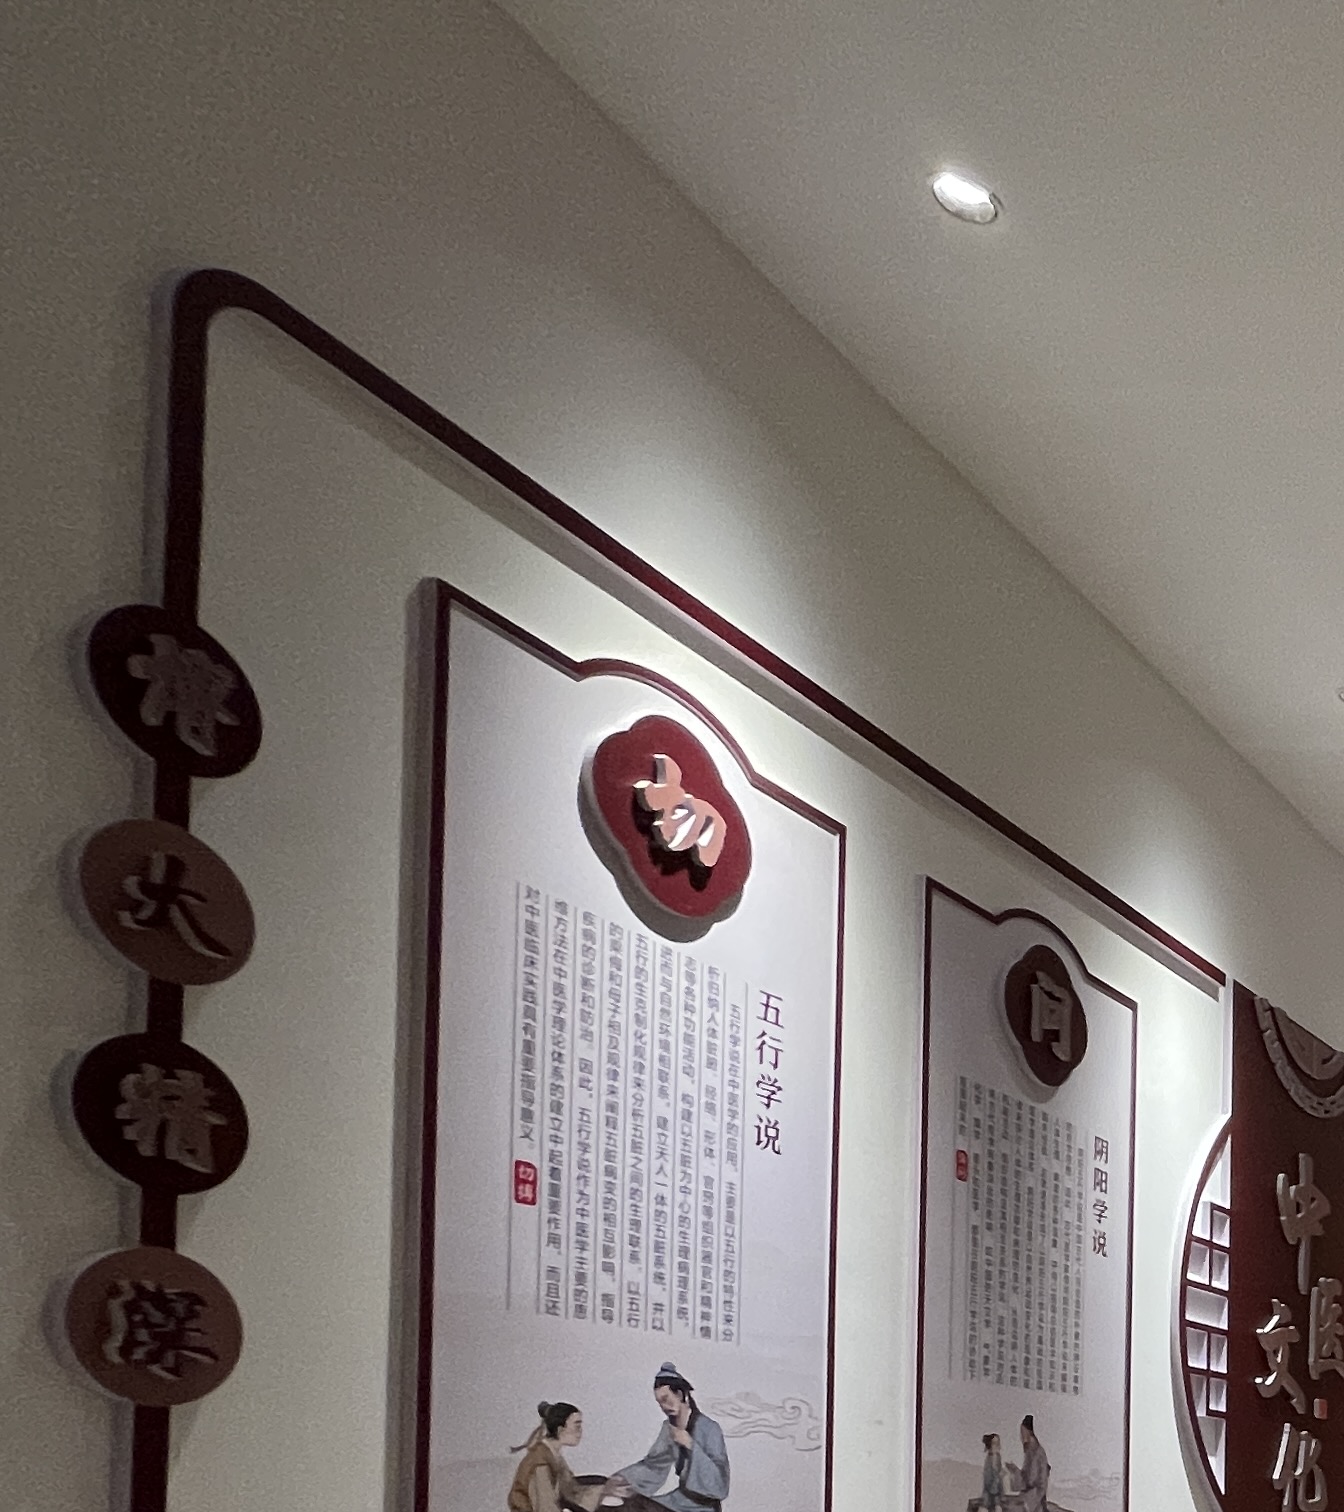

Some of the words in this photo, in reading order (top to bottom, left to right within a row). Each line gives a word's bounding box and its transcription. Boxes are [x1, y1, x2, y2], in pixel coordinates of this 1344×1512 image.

[752, 988, 786, 1157] 五行学说
[1090, 1134, 1111, 1259] 阴阳学说
